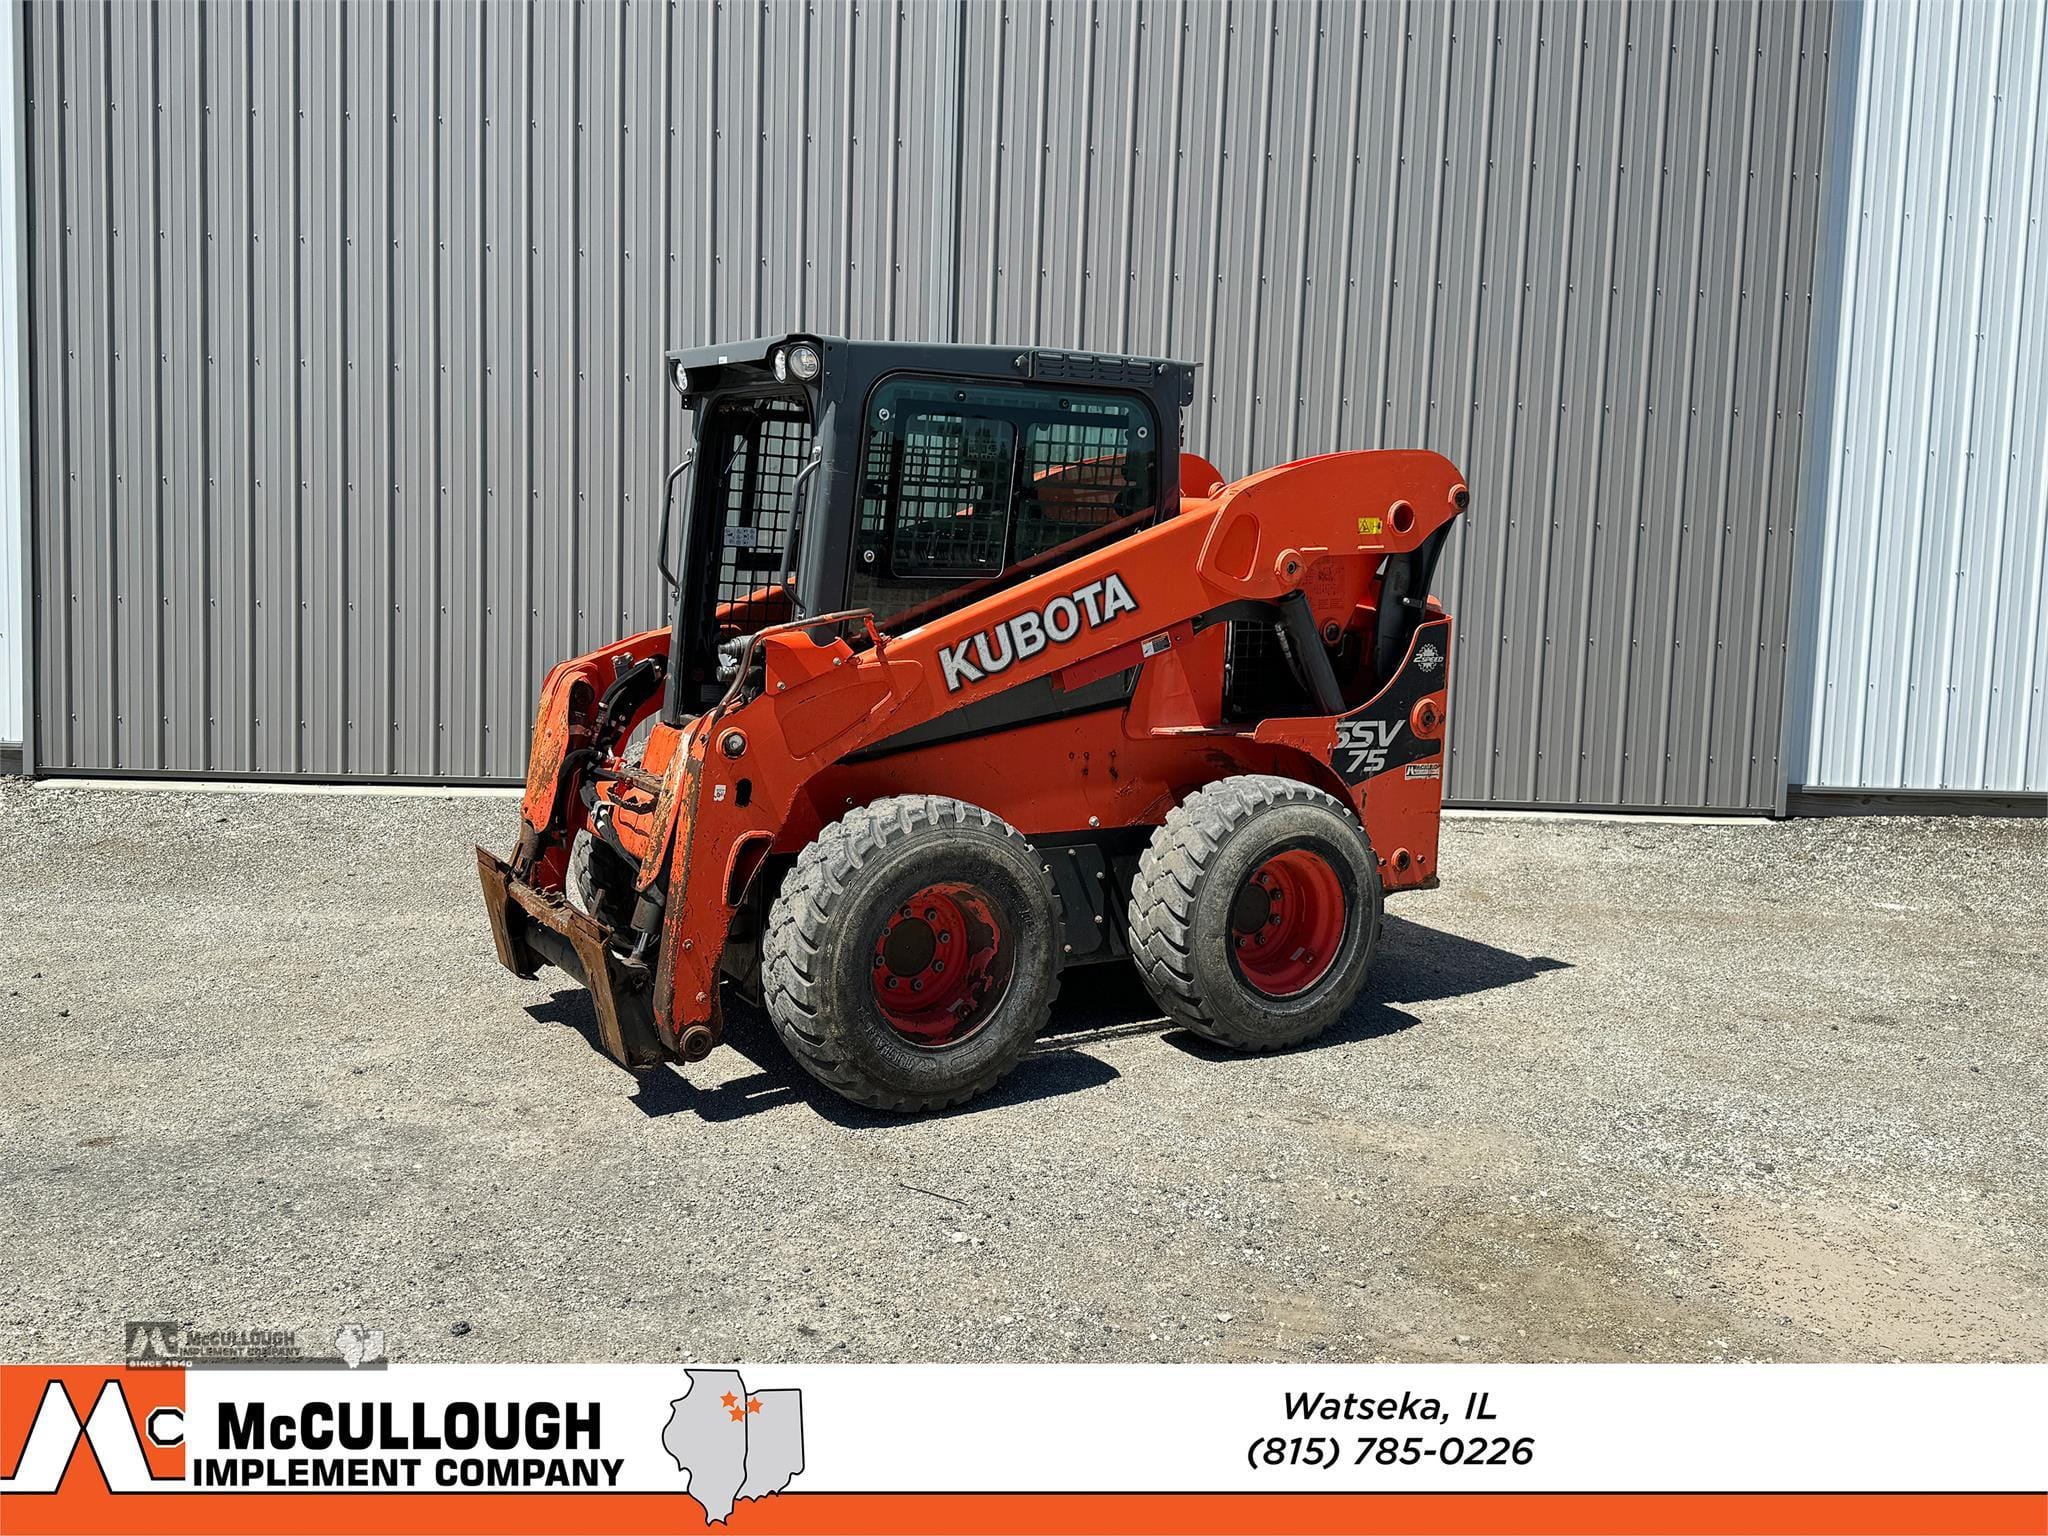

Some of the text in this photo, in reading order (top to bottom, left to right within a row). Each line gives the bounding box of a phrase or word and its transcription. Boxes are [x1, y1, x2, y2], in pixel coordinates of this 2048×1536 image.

[937, 573, 1138, 692] KUBOTA
[1335, 720, 1406, 749] SSV
[1346, 749, 1389, 773] 75
